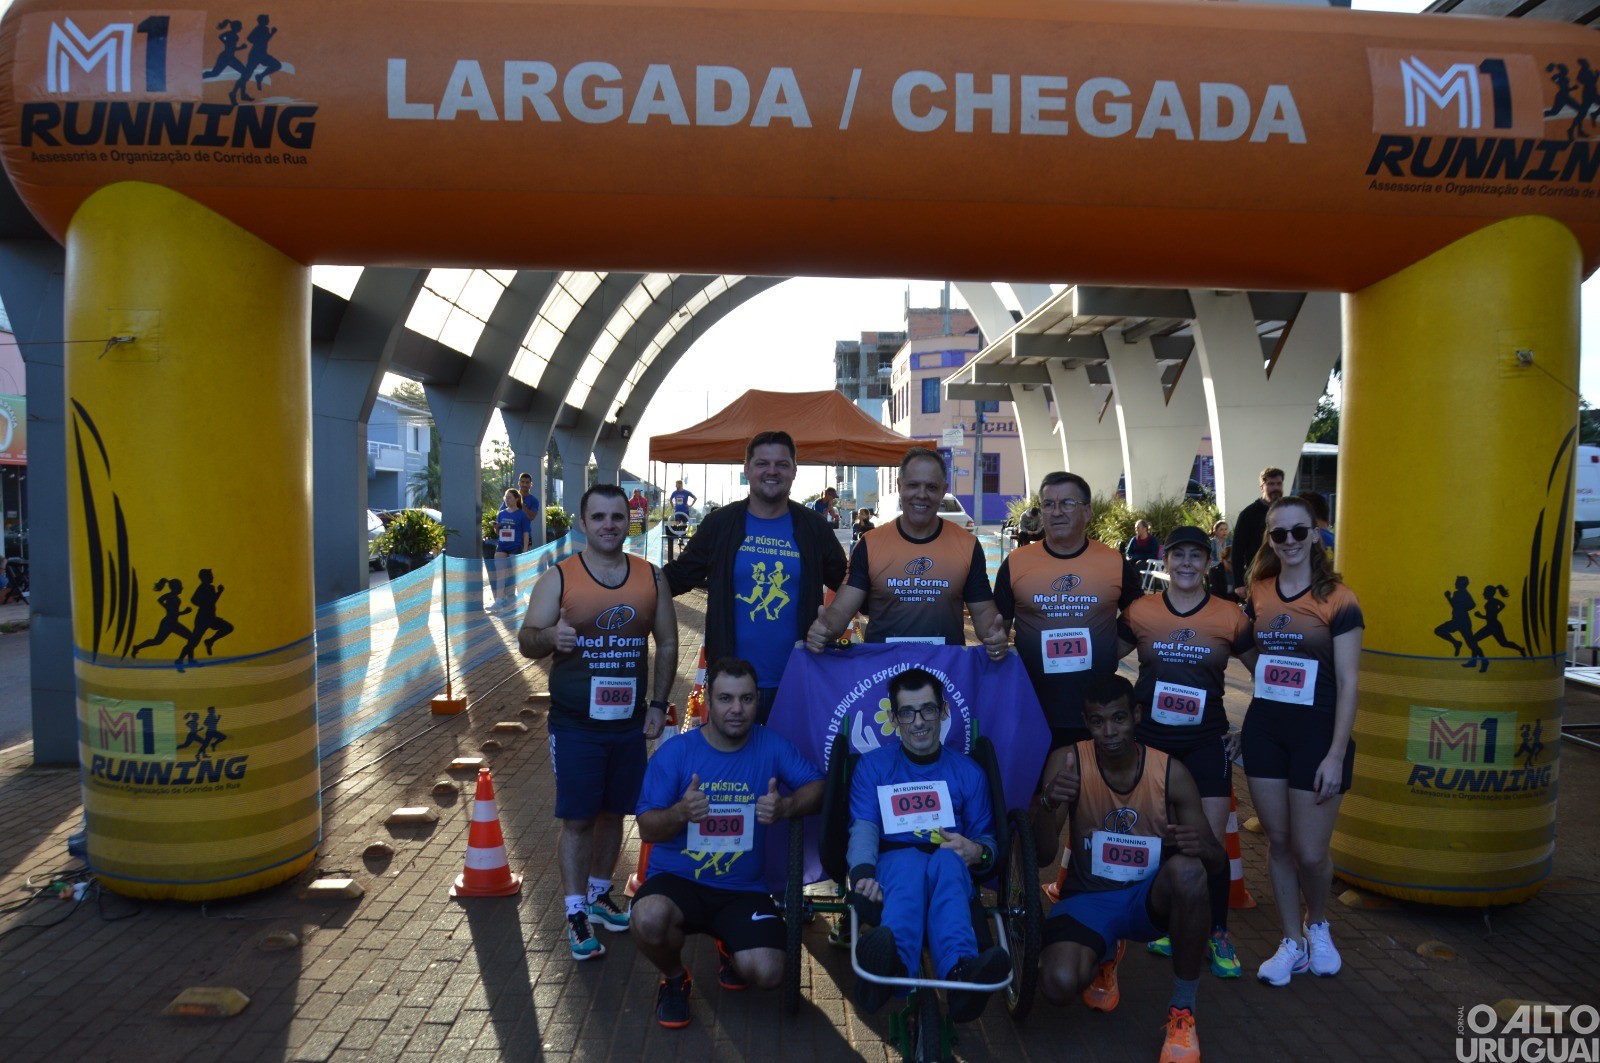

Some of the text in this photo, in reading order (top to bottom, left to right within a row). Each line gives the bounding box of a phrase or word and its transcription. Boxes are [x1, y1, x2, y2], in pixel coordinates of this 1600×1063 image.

[47, 16, 170, 93] M1
[1400, 55, 1513, 129] M1
[387, 58, 1307, 144] LARGADA / CHEGADA
[21, 102, 319, 149] RUNNING
[31, 150, 307, 165] Assessoria e Organização de Corrida de Rua
[1365, 134, 1600, 183] RUNNIN
[1369, 180, 1595, 198] Assessoria e Organização de Corrida de
[755, 535, 792, 549] RÚSTICA
[756, 547, 778, 556] CLUBE
[887, 578, 949, 588] Med Forma
[1033, 594, 1098, 603] Med Forma
[575, 634, 646, 648] Med Forma
[1257, 631, 1304, 640] Med Forma
[581, 649, 641, 659] Academia
[1053, 640, 1082, 655] 121
[1152, 641, 1211, 654] Med Forma
[1158, 650, 1203, 660] Academia
[625, 661, 636, 669] RS
[1269, 668, 1302, 686] 024
[601, 689, 630, 703] 086
[834, 679, 872, 718] EDUCAÇÃO
[952, 691, 965, 707] DA
[1163, 695, 1197, 713] 050
[99, 706, 155, 755] M1
[828, 717, 841, 733] DE
[1428, 716, 1498, 764] M1
[90, 754, 249, 786] RUNNING
[1407, 763, 1552, 792] RUNNING
[171, 786, 181, 794] de
[183, 786, 212, 794] Corrida
[226, 781, 241, 789] Rua
[711, 780, 749, 792] RÚSTICA
[893, 785, 934, 794] M1RUNNING
[898, 794, 936, 812] 036
[705, 818, 740, 833] 030
[1106, 836, 1147, 846] M1RUNNING
[1108, 847, 1146, 864] 058
